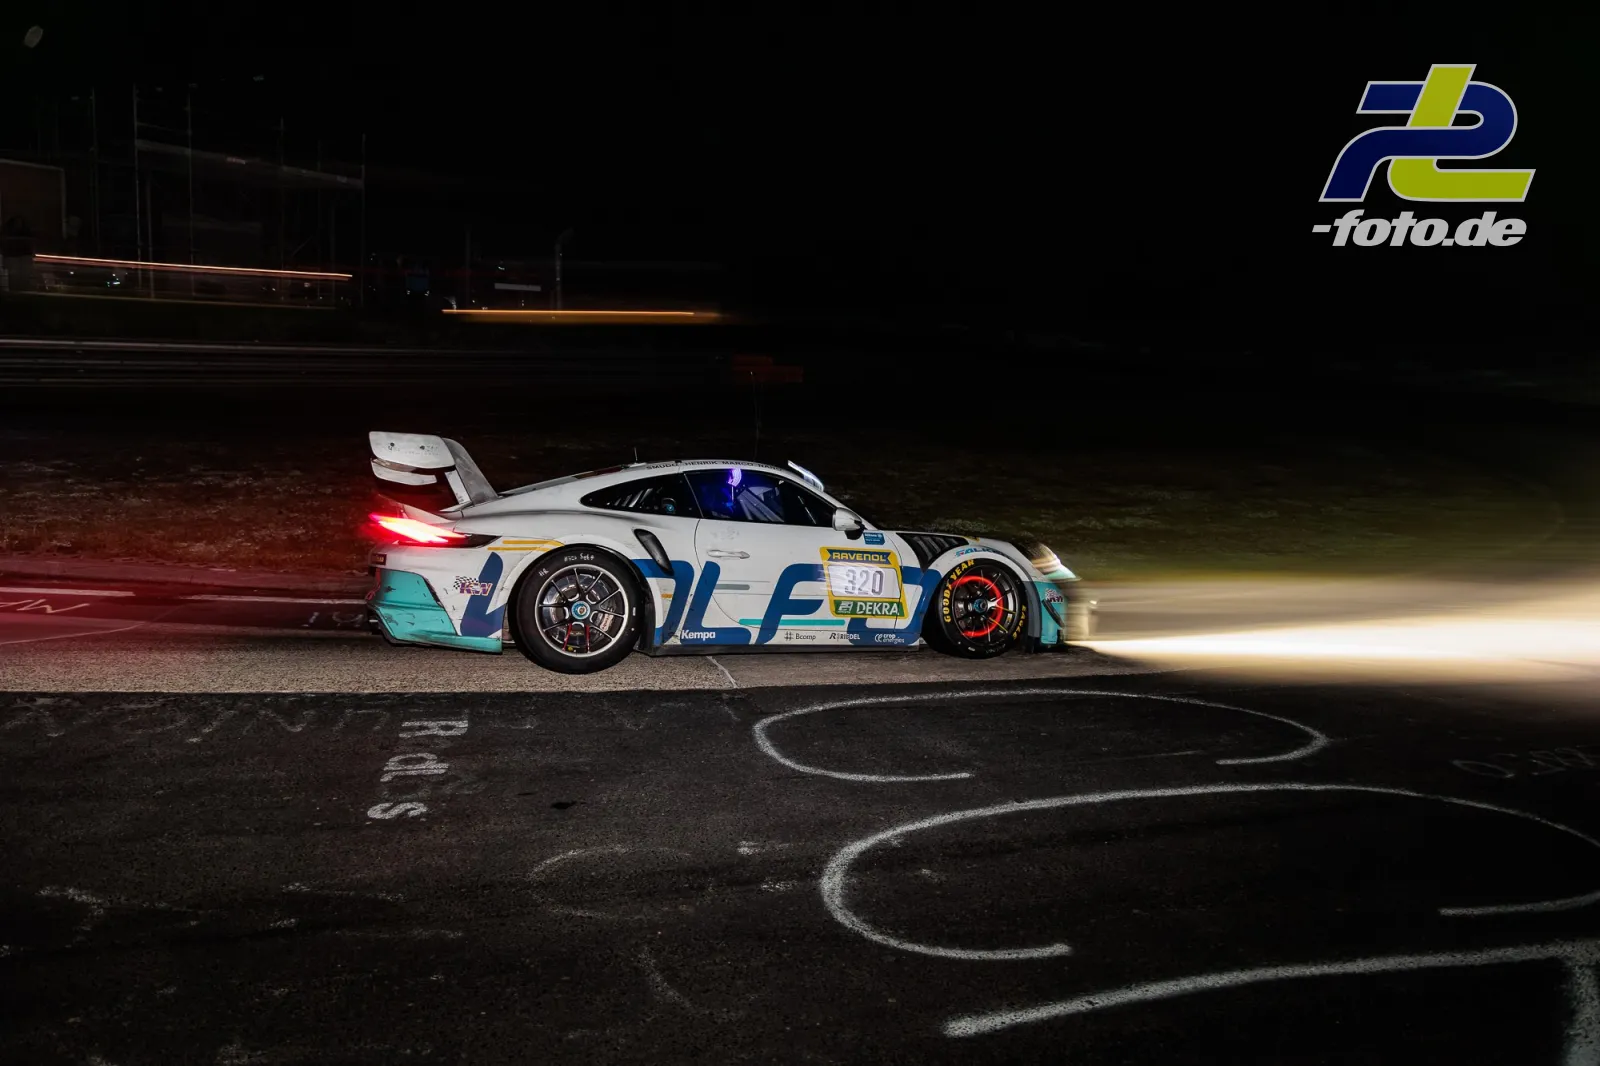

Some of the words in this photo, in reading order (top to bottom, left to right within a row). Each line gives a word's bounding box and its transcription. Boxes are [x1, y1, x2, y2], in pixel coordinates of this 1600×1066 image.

[832, 552, 887, 562] RAVENOL
[844, 569, 885, 596] 320
[856, 602, 900, 616] DEKRA
[681, 629, 717, 642] Kempa
[795, 633, 817, 642] Bcomp
[840, 633, 861, 641] RIEDEL
